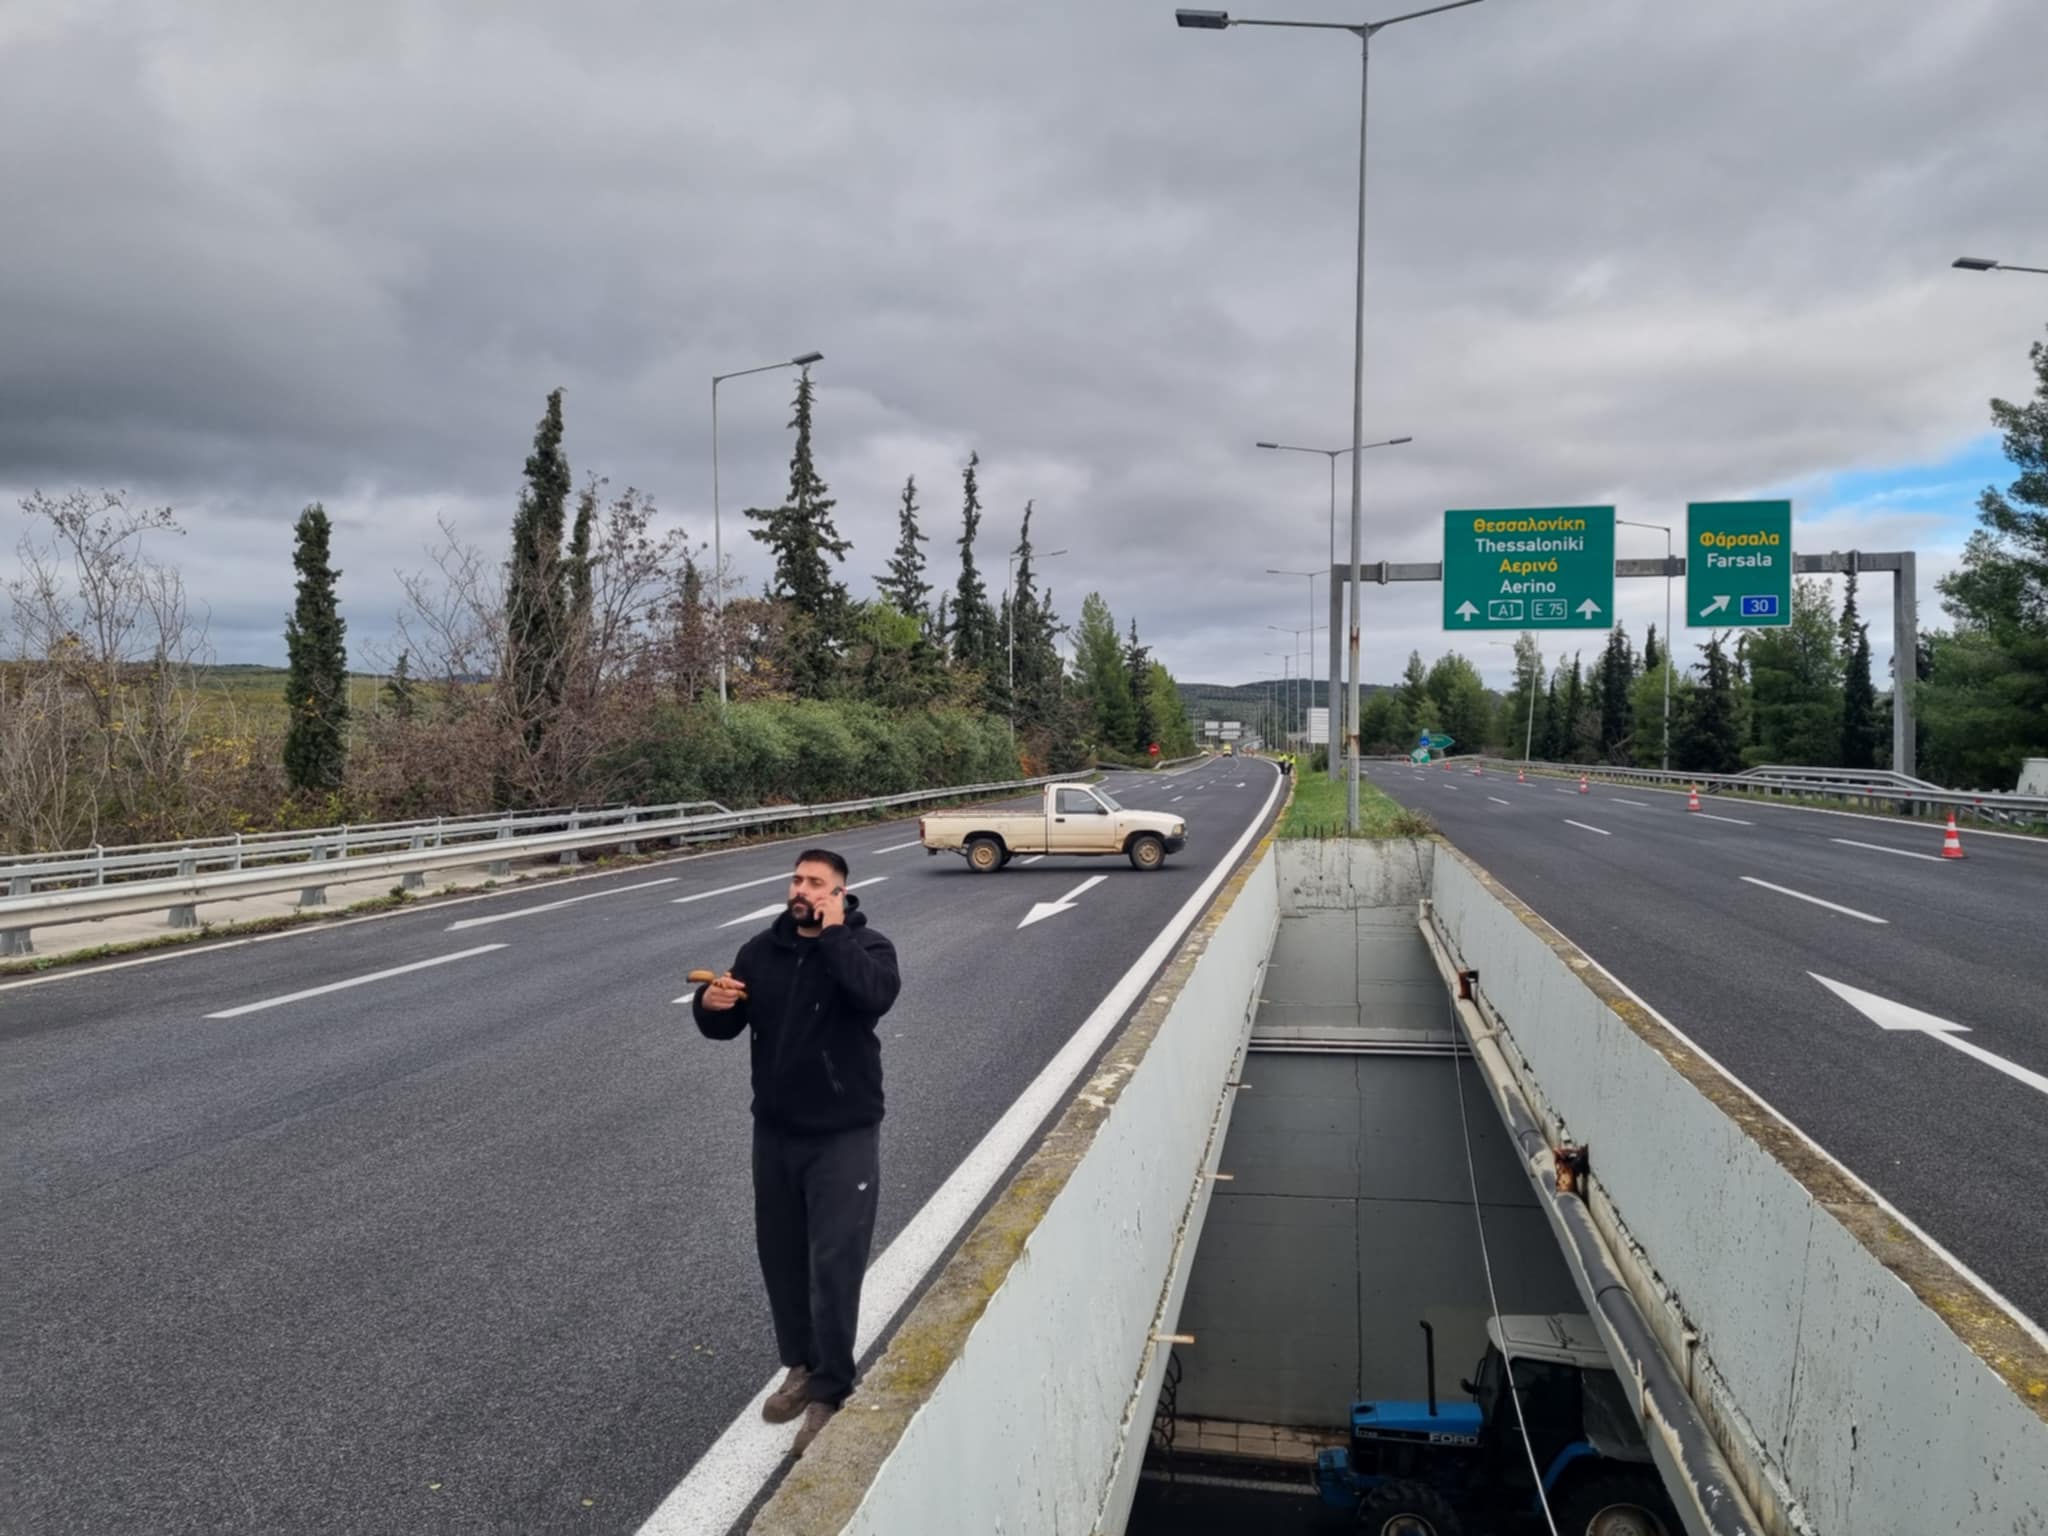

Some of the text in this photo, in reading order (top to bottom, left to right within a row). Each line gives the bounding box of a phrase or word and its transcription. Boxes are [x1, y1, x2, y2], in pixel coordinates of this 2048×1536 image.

[1473, 516, 1586, 533] Θεσσαλονίκη
[1475, 536, 1584, 553] Thessaloniki
[1700, 530, 1779, 550] Φάρσαλα
[1499, 557, 1558, 576] Αερινό
[1707, 552, 1773, 568] Farsala
[1500, 579, 1556, 594] Aerino
[1498, 603, 1514, 617] A1
[1535, 603, 1564, 617] E 75
[1751, 599, 1769, 613] 30
[1429, 1432, 1479, 1446] FORD
